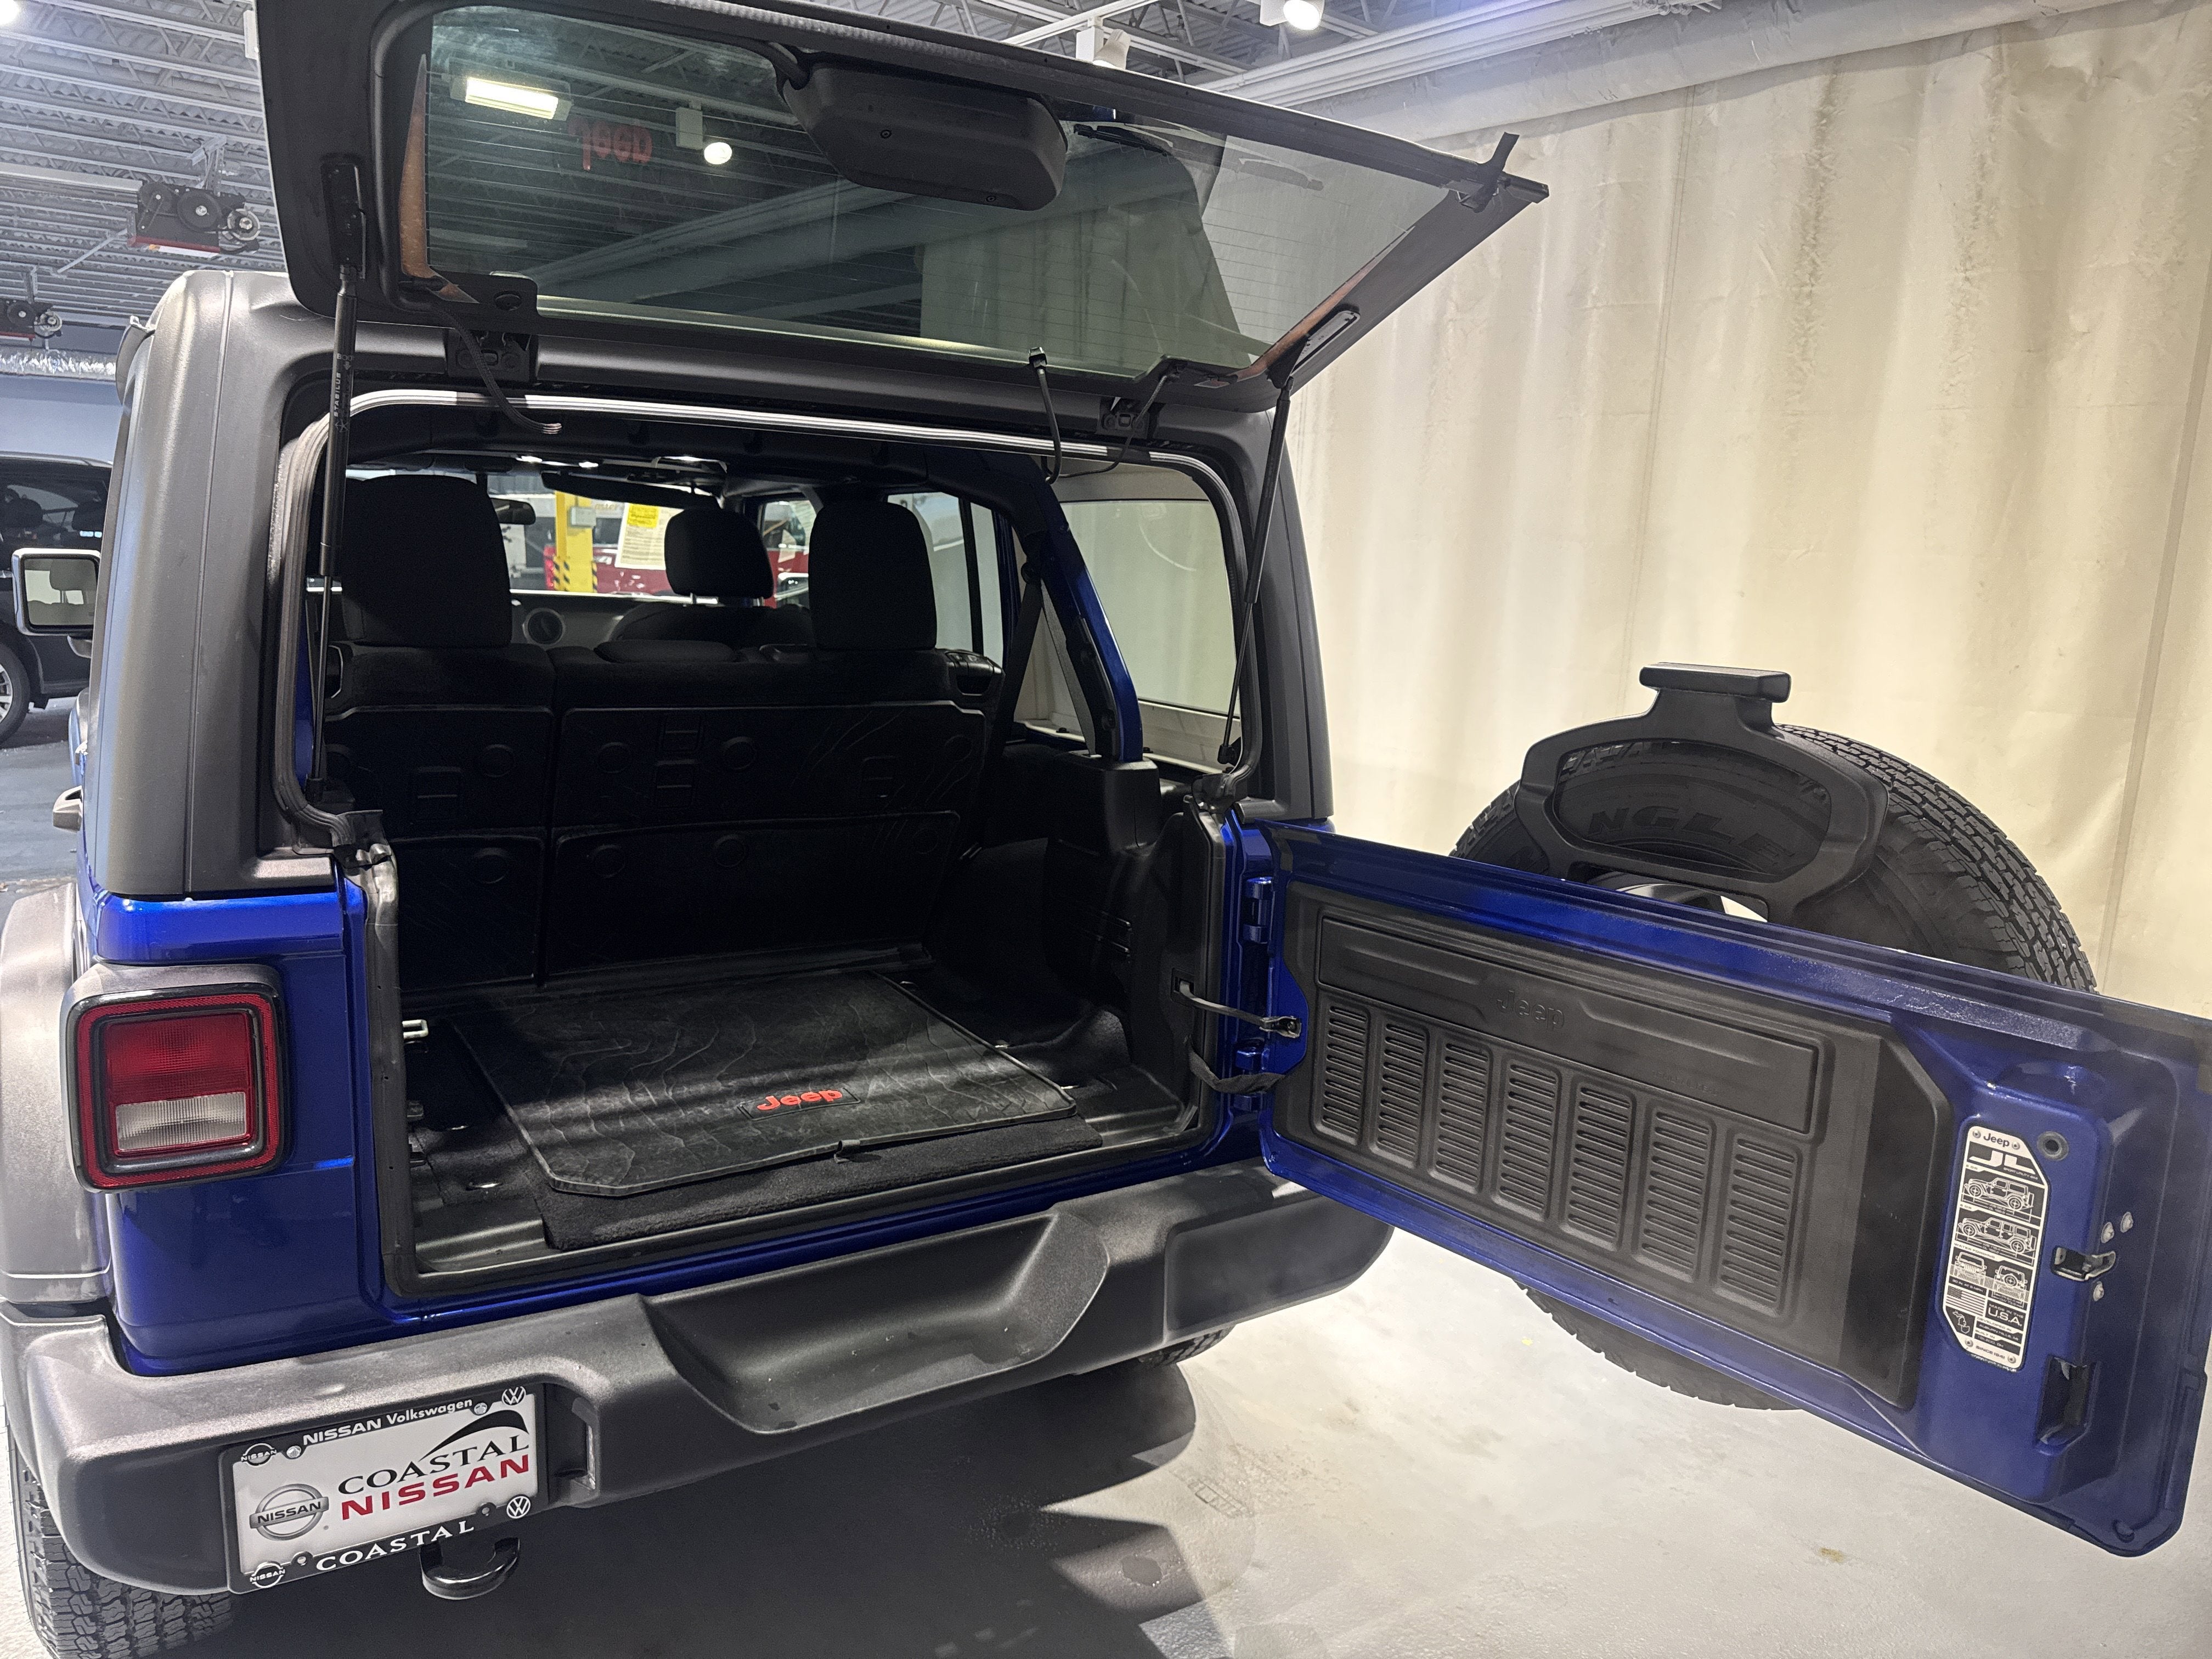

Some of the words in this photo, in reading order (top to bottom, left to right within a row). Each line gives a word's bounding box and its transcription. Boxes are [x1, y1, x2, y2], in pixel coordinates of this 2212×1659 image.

[1497, 990, 1565, 1030] Jeep
[757, 1090, 843, 1110] Jeep
[1983, 1133, 2010, 1147] Jeep
[1969, 1150, 2035, 1175] JL
[1954, 1243, 1972, 1251] WATER
[1972, 1249, 1995, 1259] FORDING
[1988, 1307, 2023, 1327] U.S.A.
[1989, 1303, 2005, 1312] MADE
[1977, 1316, 2006, 1329] DEVELOPED
[1976, 1345, 1993, 1355] SINCE
[303, 1418, 382, 1446] NISSAN
[386, 1398, 473, 1426] Volkswagen
[240, 1449, 277, 1462] NISSAN
[338, 1435, 529, 1494] COASTAL
[341, 1454, 529, 1520] NISSAN
[257, 1501, 321, 1524] NISSAN
[315, 1521, 475, 1571] COASTAL
[249, 1568, 286, 1583] NISSAN
